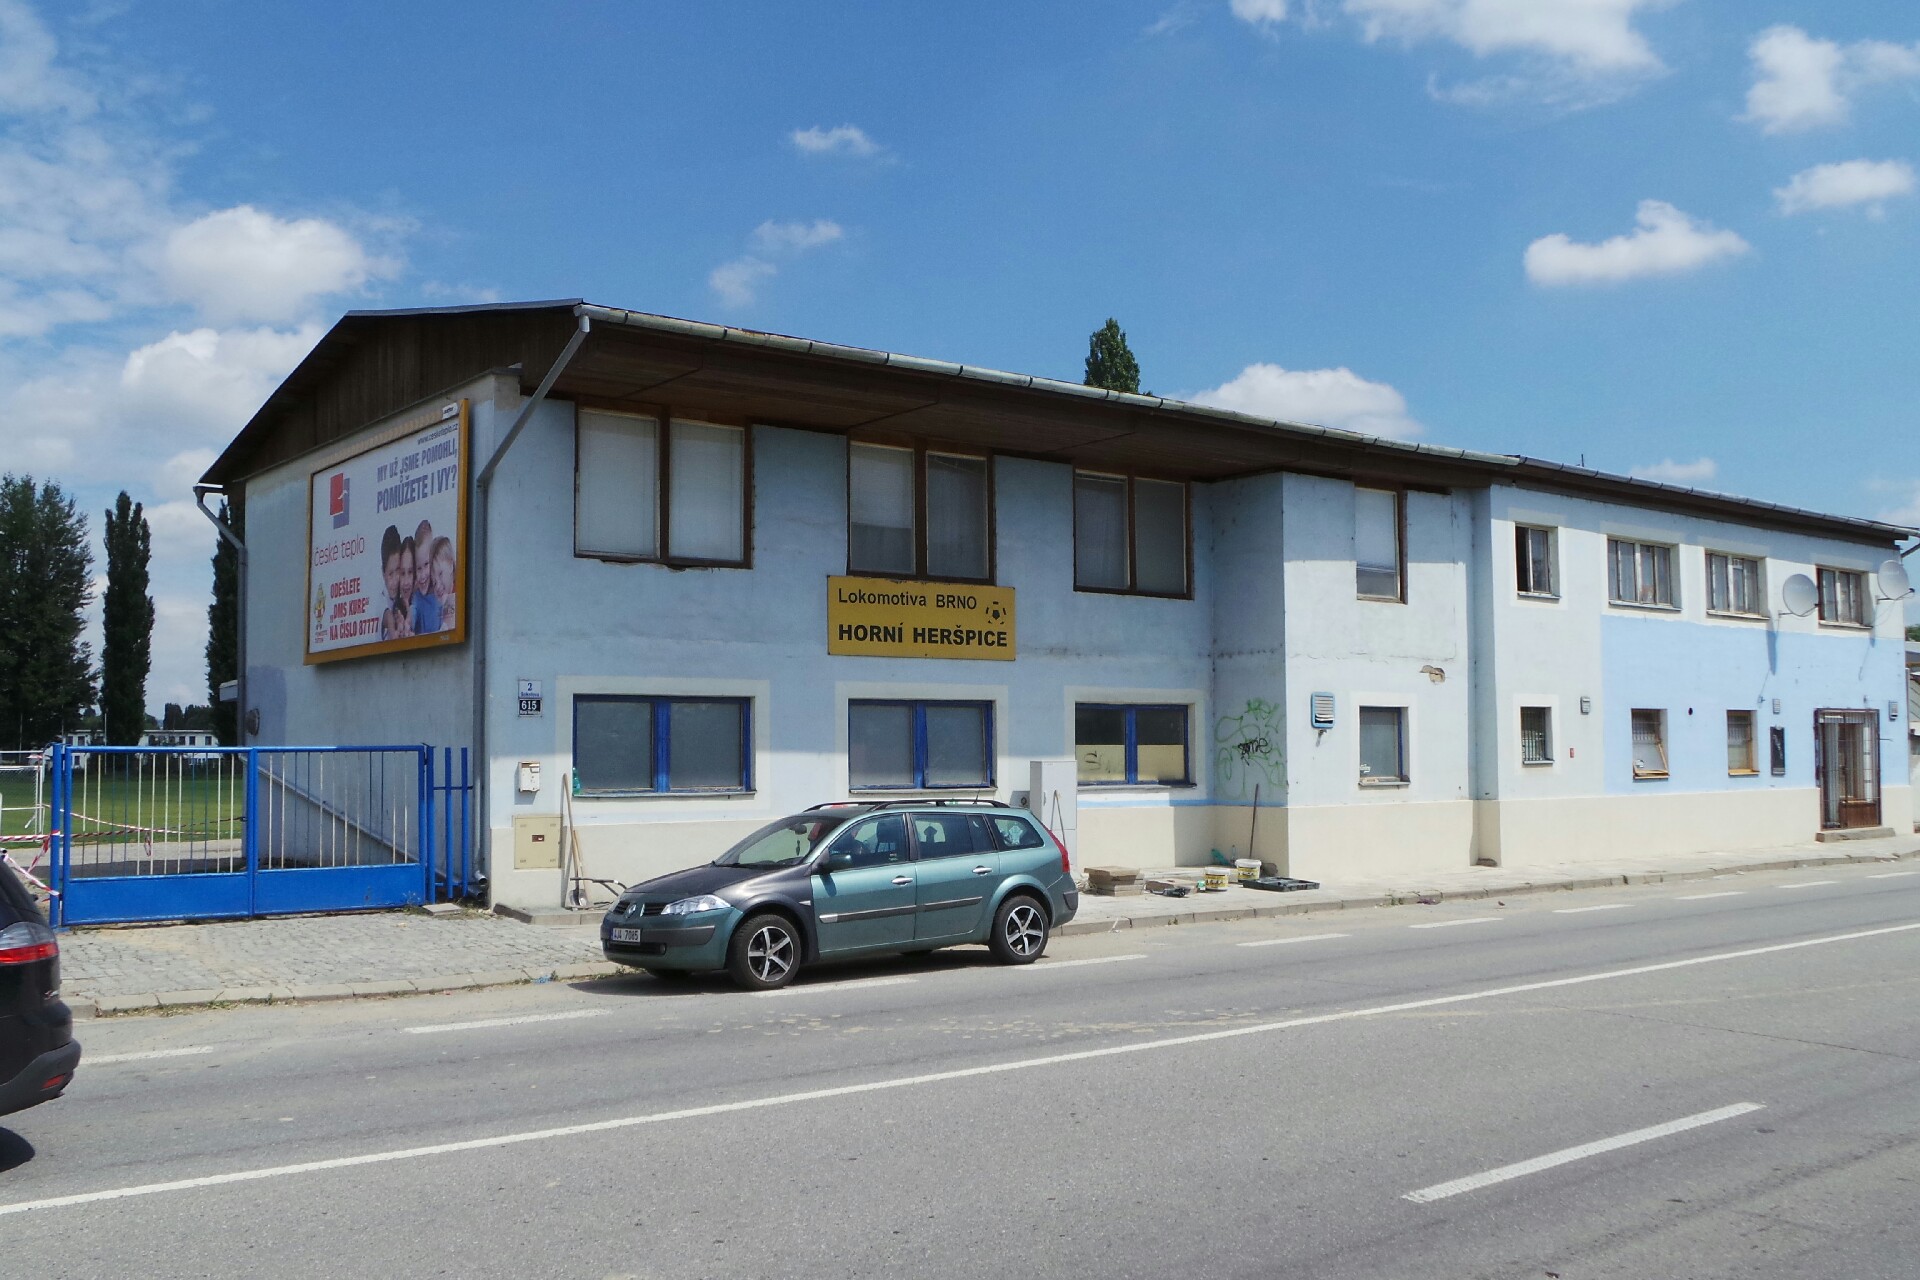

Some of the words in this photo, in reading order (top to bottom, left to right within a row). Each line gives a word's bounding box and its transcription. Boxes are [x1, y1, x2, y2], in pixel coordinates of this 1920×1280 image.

[377, 464, 388, 483] MY
[389, 457, 399, 479] UŽ
[399, 452, 420, 474] JSME
[421, 438, 458, 466] POMOHLI,
[377, 474, 428, 514] POMŮŽETE
[430, 472, 435, 495] I
[437, 464, 458, 494] VY?
[314, 541, 339, 567] české
[341, 533, 365, 560] teplo
[330, 577, 361, 599] ODEŠLETE
[838, 588, 927, 607] Lokomotiva
[935, 594, 978, 610] BRNO
[329, 624, 338, 641] NA
[339, 619, 358, 639] ČÍSLO
[358, 617, 380, 636] 87777
[838, 622, 904, 643] HORNÍ
[913, 625, 1008, 647] HERŠPICE
[528, 682, 533, 691] 2
[521, 700, 537, 710] 615
